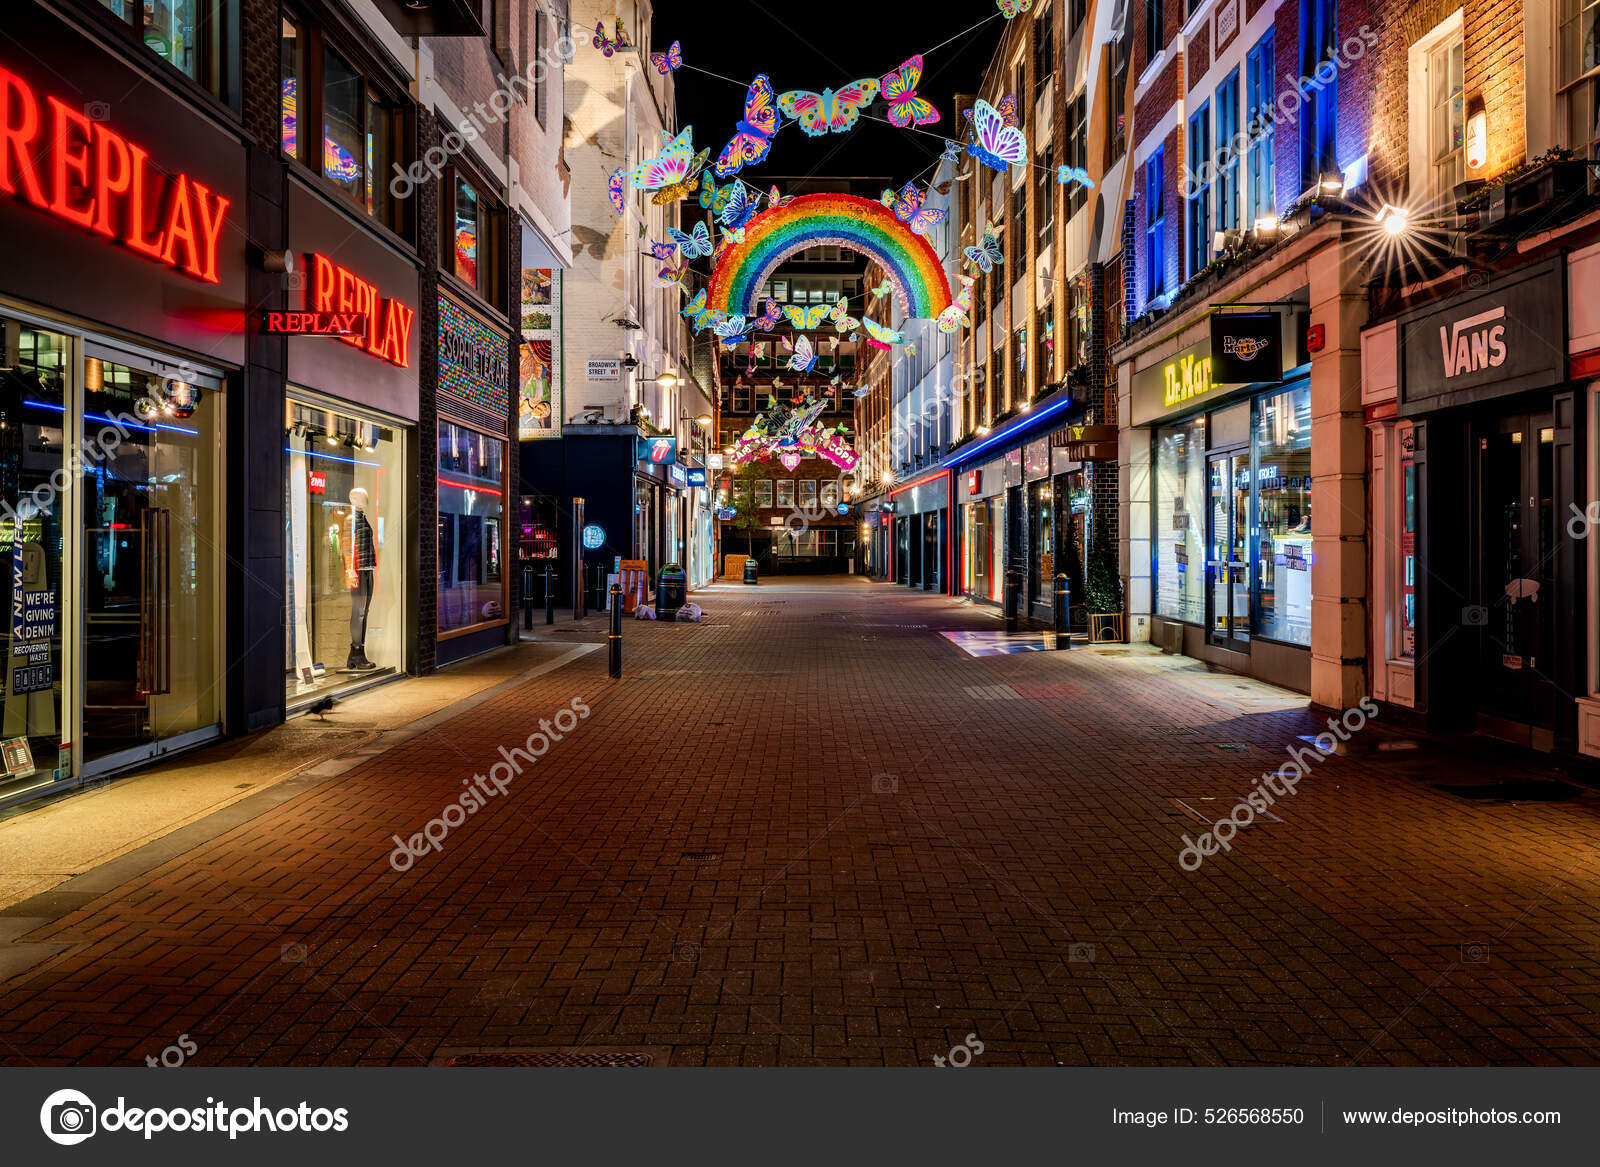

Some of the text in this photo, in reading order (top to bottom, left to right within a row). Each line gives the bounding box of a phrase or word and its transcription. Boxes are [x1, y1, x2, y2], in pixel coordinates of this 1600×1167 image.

[0, 67, 230, 284] REPLAY
[314, 253, 415, 368] REPLAY
[267, 312, 358, 332] REPLAY
[1440, 306, 1507, 378] VANS
[13, 514, 24, 640] A NEW LIFE
[25, 591, 55, 605] WE'RE
[25, 608, 55, 623] GIVING
[25, 624, 55, 639] DENIM
[13, 643, 48, 656] RECOVERING
[29, 652, 48, 663] WASTE
